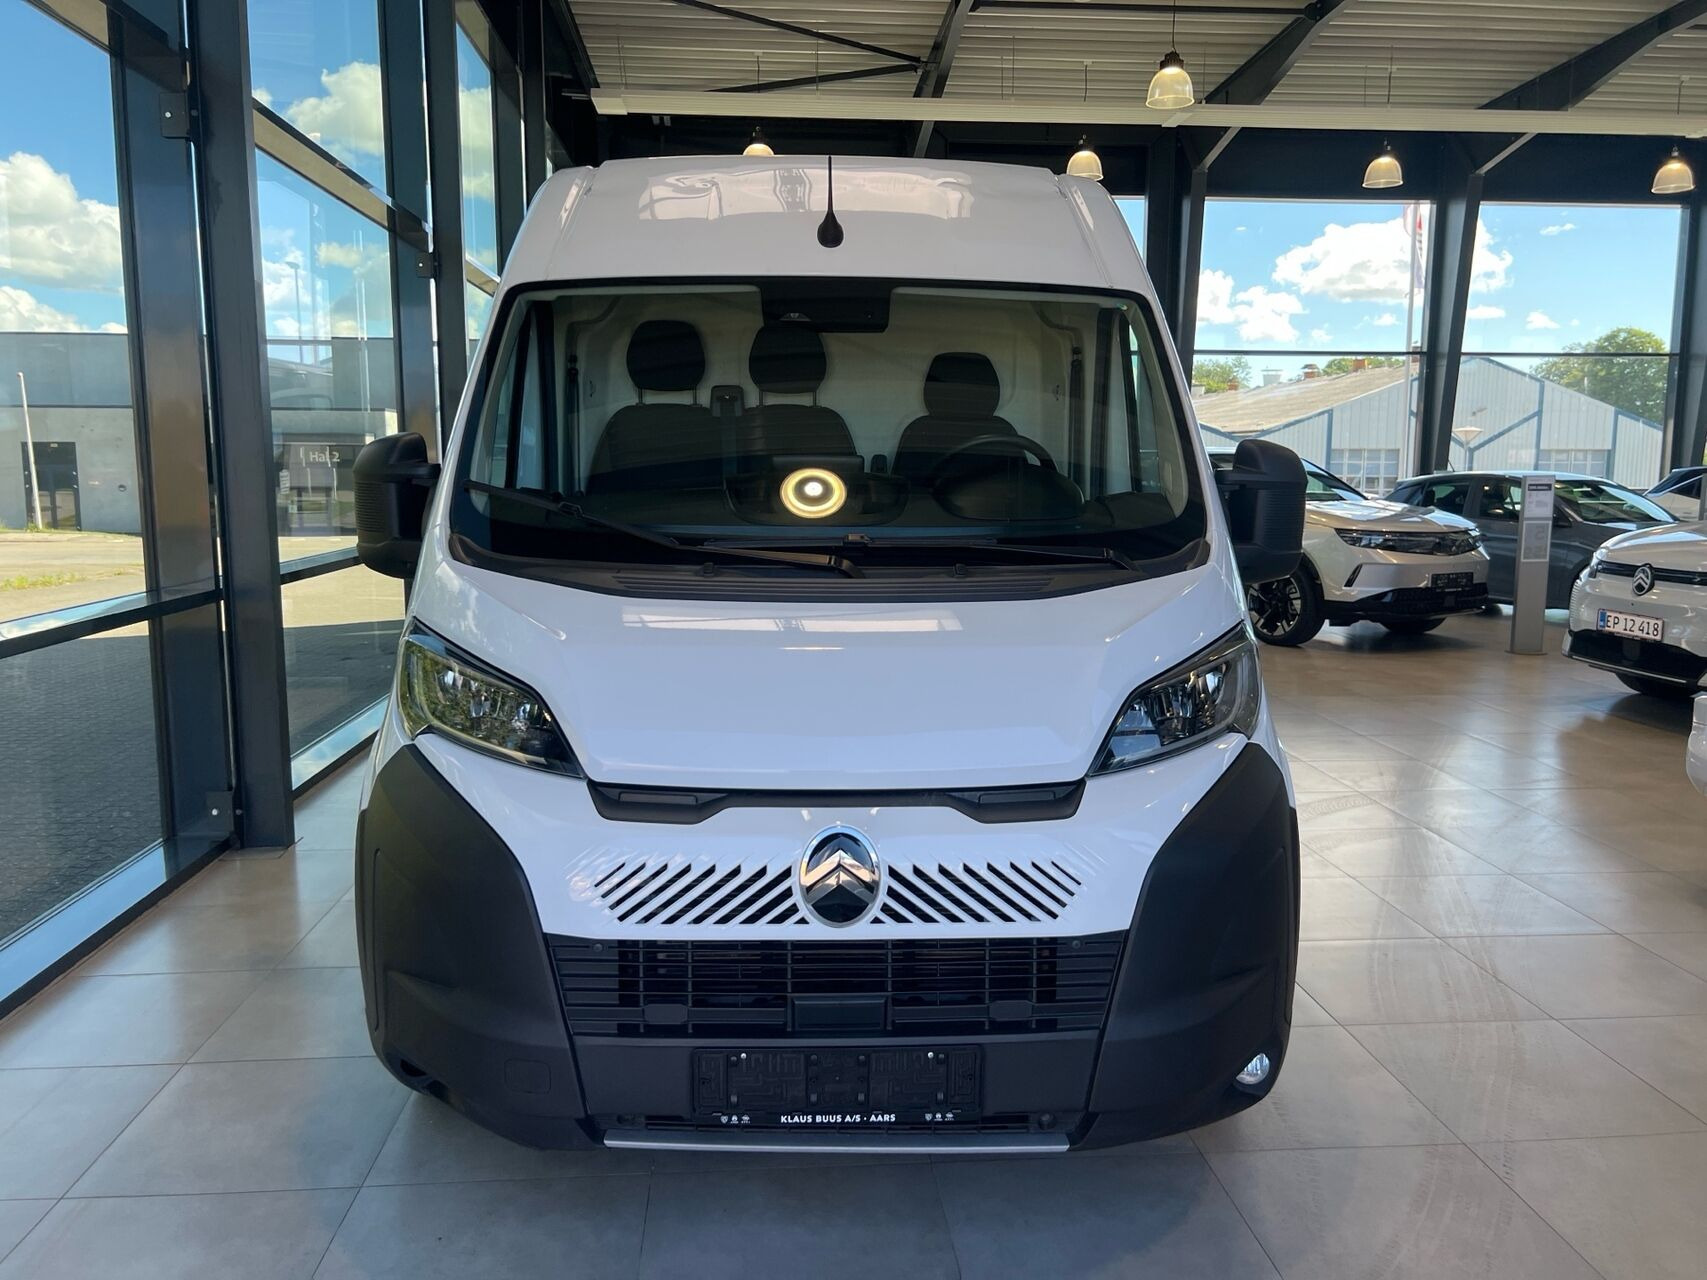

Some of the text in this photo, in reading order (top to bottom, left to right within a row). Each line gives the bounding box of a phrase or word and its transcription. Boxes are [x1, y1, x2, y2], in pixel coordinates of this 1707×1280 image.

[332, 451, 340, 462] 2
[1606, 615, 1659, 637] EP 12 418
[780, 1113, 896, 1123] KLAUS BUUS A/S AARS
